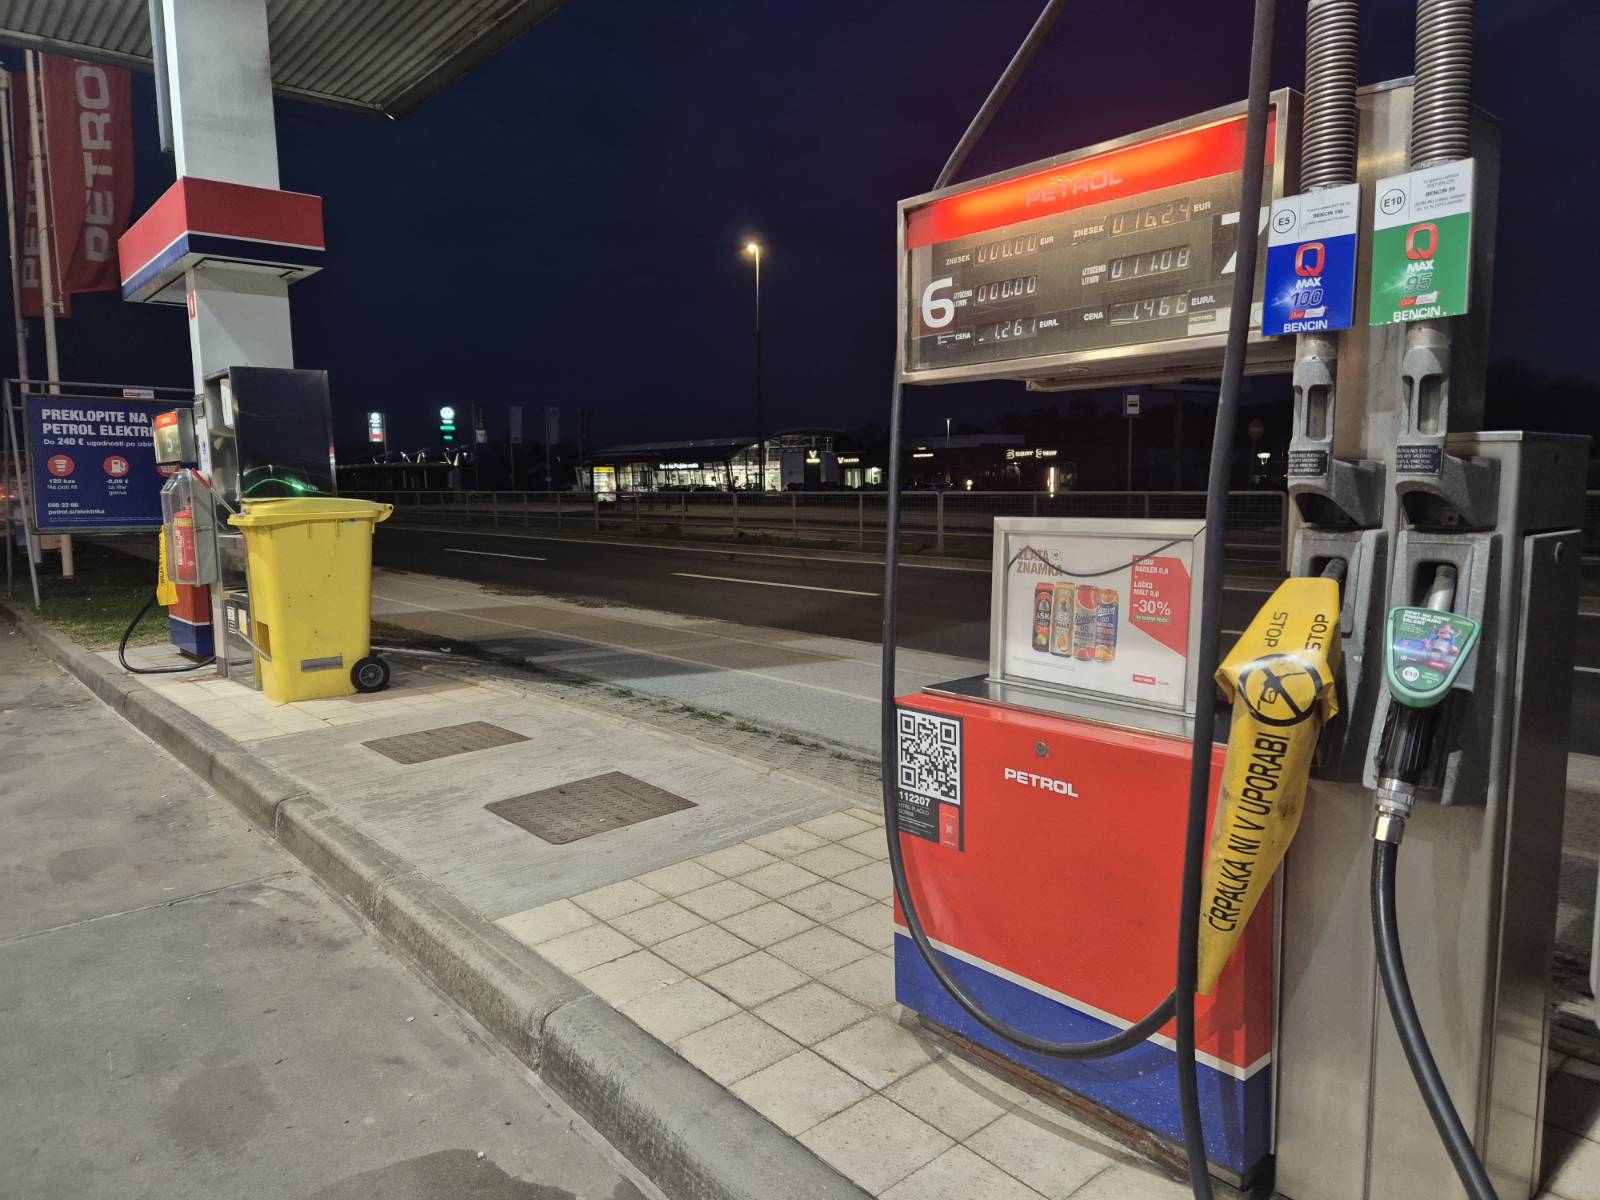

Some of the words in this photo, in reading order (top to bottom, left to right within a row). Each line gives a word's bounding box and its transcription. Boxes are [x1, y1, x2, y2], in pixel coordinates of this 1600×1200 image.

[74, 58, 114, 263] PETRO
[1026, 167, 1123, 207] PETROL
[1193, 201, 1212, 213] EUR
[1383, 195, 1403, 208] E10
[1278, 216, 1291, 227] E5
[1073, 224, 1105, 238] ZNESEK
[1039, 235, 1055, 246] EUR
[1405, 223, 1439, 261] Q
[945, 253, 971, 266] ZNESEK
[1295, 242, 1326, 277] Q
[1406, 260, 1435, 274] MAX
[1296, 277, 1322, 289] MAX
[1404, 273, 1433, 293] 95
[921, 276, 955, 329] 6
[1191, 294, 1216, 306] EUR/L
[1291, 288, 1324, 307] 100
[1083, 311, 1104, 321] CENA
[1392, 306, 1442, 323] BENCIN
[1283, 320, 1328, 334] BENCIN
[955, 332, 972, 341] CENA
[41, 408, 125, 423] PREKLOPITE
[128, 412, 148, 423] NA
[42, 423, 97, 436] PETROL
[57, 437, 76, 446] 240
[78, 437, 84, 446] €
[86, 440, 124, 448] ugodnosti
[1016, 560, 1063, 577] ZNAMKA
[1132, 599, 1171, 616] -30%
[1264, 611, 1289, 648] STOP
[1304, 613, 1329, 650] STOP
[1237, 732, 1290, 815] UPORABI
[1004, 767, 1079, 798] PETROL
[899, 790, 931, 807] 112207
[1232, 815, 1265, 830] V
[1228, 833, 1261, 855] NI
